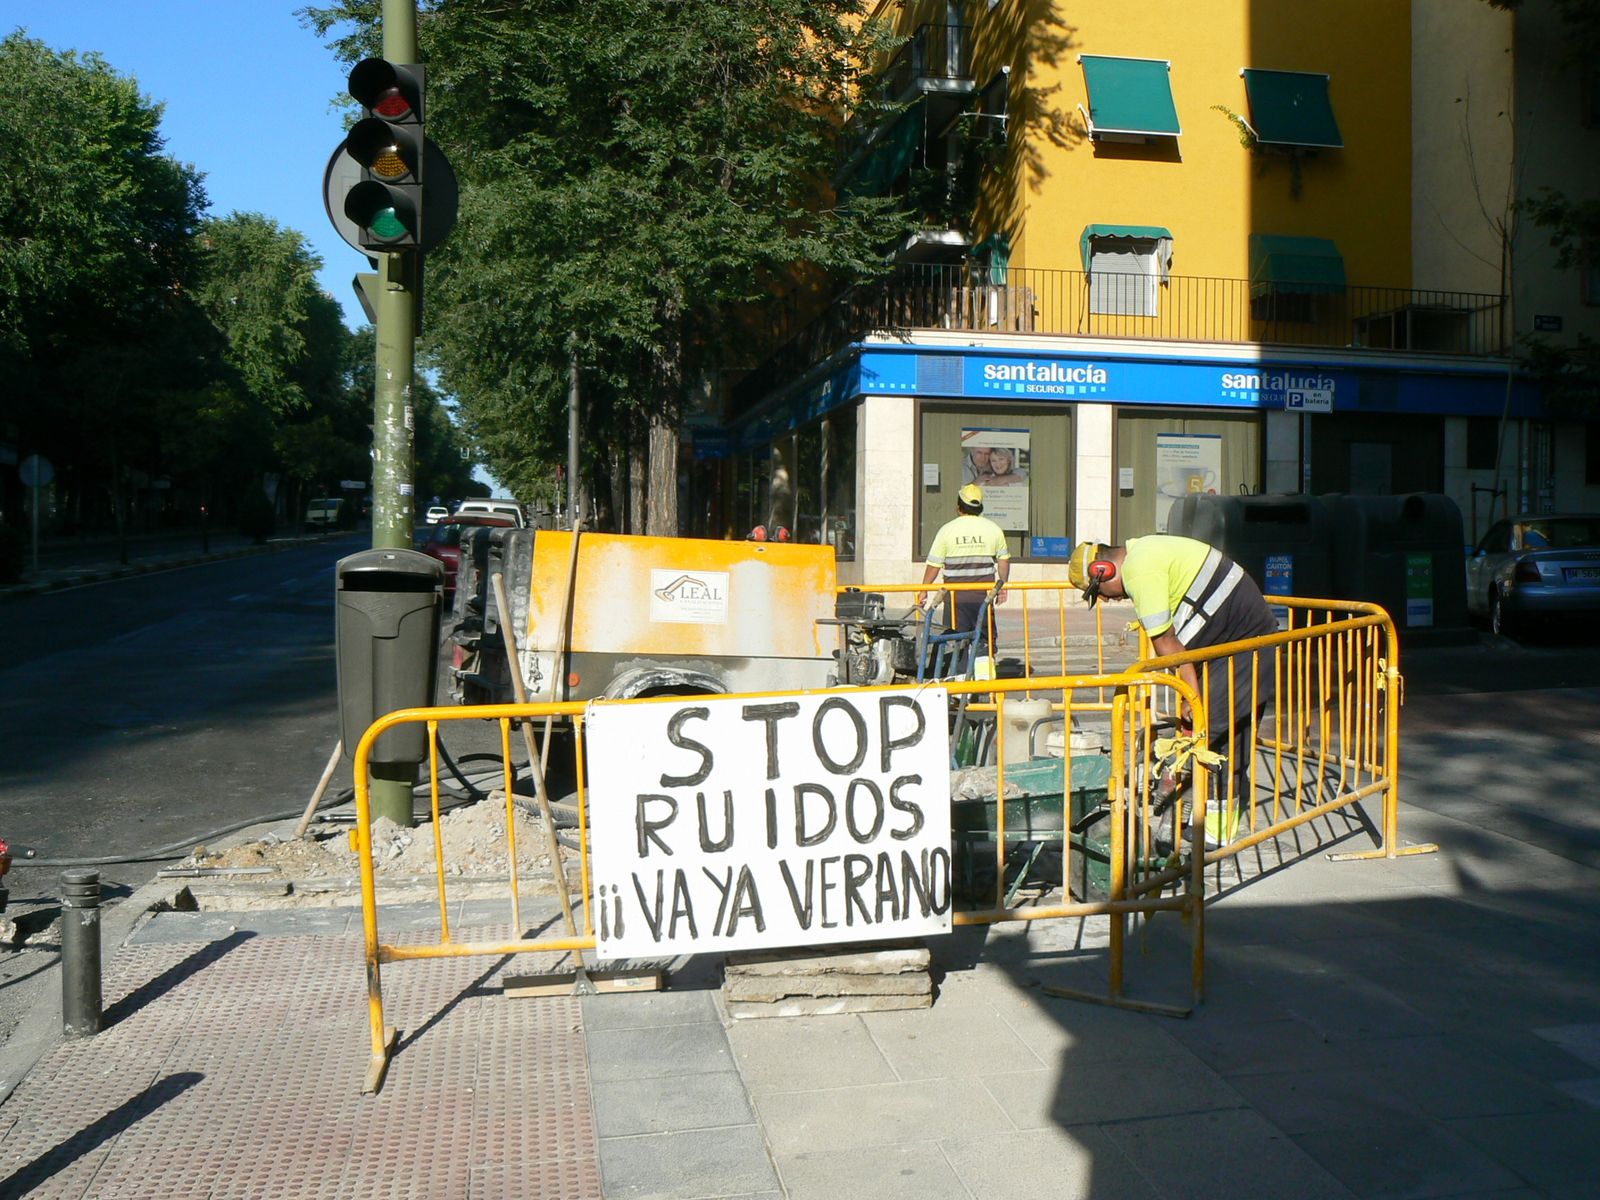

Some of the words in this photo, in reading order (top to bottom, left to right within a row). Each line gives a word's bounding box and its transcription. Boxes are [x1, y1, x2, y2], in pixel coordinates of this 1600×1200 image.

[984, 362, 1107, 384] santalucía
[1221, 372, 1336, 392] santalucía
[1026, 384, 1064, 393] SEGUROS
[1291, 394, 1301, 405] P
[955, 535, 985, 544] LEAL
[680, 586, 722, 600] LEAL
[660, 695, 926, 788] STOP
[635, 774, 925, 858] RUIDOS
[779, 847, 950, 930] VERANO
